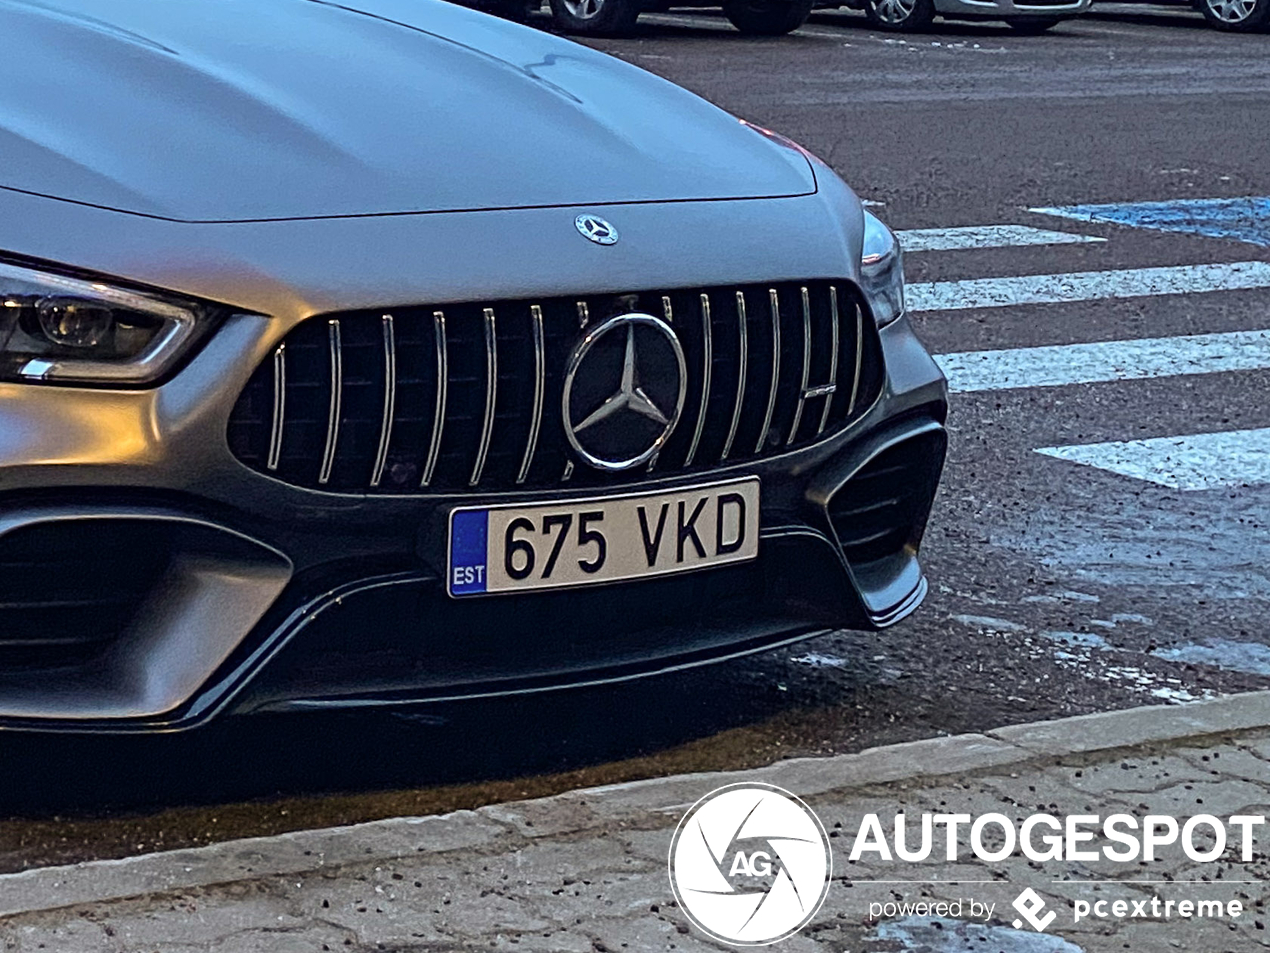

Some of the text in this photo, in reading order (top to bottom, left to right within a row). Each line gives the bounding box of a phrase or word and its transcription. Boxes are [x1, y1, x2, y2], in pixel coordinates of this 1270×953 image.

[504, 492, 746, 581] 675 VKD
[453, 565, 486, 585] EST
